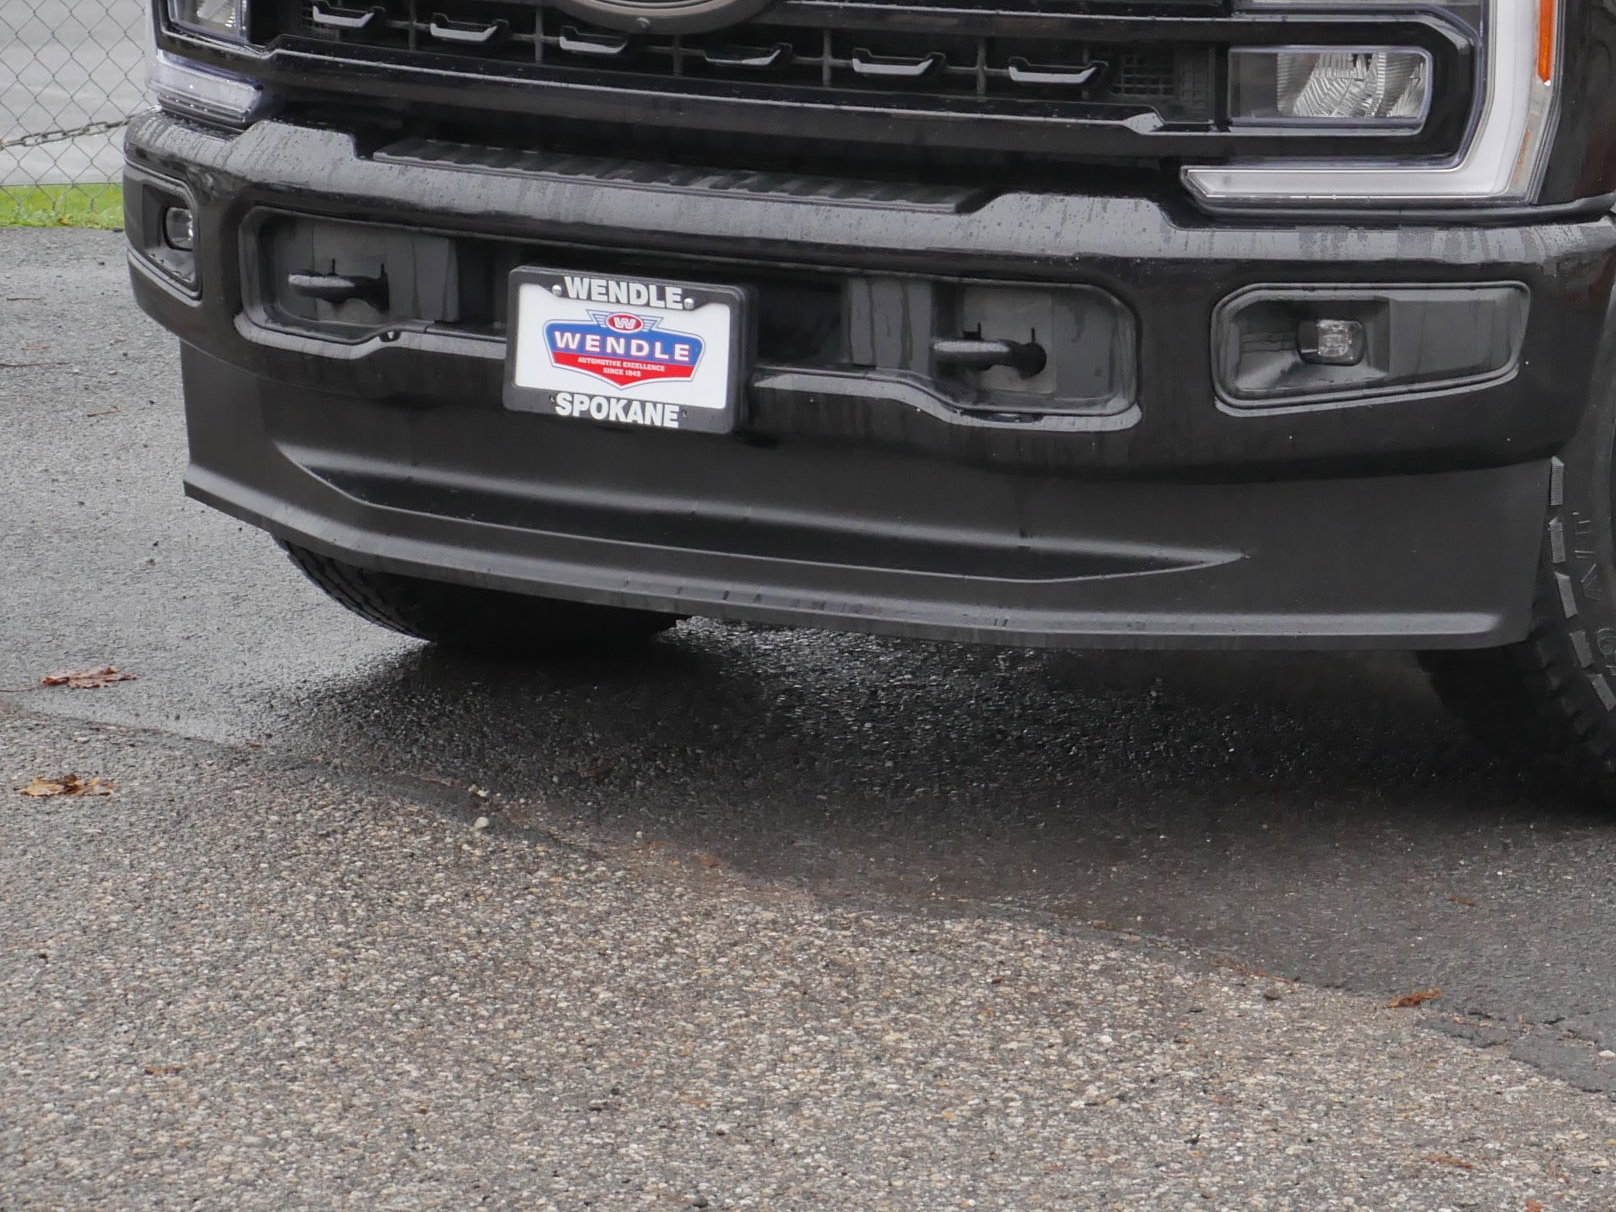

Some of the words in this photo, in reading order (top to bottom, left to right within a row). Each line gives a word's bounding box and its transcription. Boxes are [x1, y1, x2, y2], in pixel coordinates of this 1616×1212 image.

[563, 275, 684, 310] WENDLE
[553, 330, 690, 362] WENDLE
[577, 356, 622, 368] AUTOMOTIVE
[622, 361, 666, 372] EXCELLENCE
[602, 367, 624, 376] SINCE
[554, 392, 680, 429] SPOKANE
